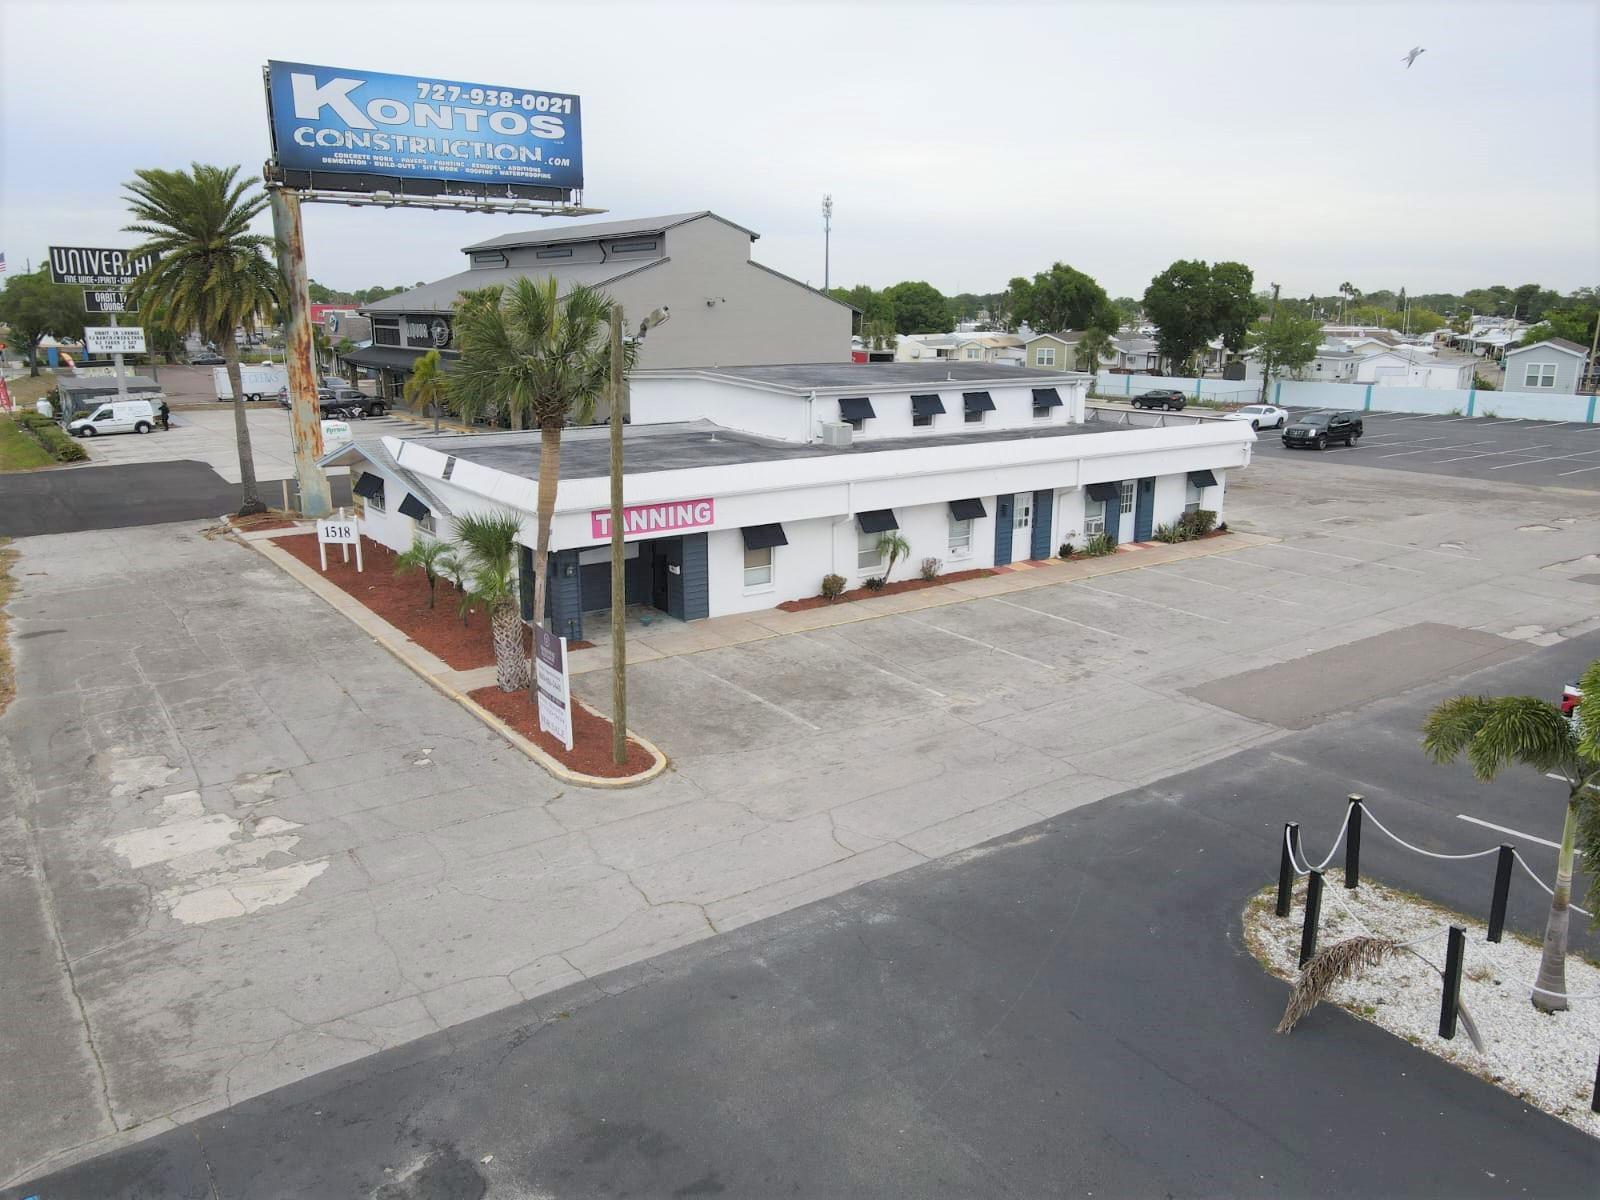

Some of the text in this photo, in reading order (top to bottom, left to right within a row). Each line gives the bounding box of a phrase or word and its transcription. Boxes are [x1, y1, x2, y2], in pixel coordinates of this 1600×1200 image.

[417, 82, 572, 115] 727-938-0021
[290, 72, 566, 140] KONTOS
[293, 126, 543, 162] CONSTRUCTION
[334, 152, 370, 161] CONCRETE
[322, 157, 367, 166] DEMOLITION
[374, 161, 416, 170] BUILD-OUTS
[499, 170, 552, 180] WATERPROOFING
[64, 275, 77, 283] FINE
[79, 275, 94, 284] WINE
[95, 292, 116, 302] ORBIT
[100, 302, 125, 311] LOUNGE
[325, 526, 351, 538] 1518
